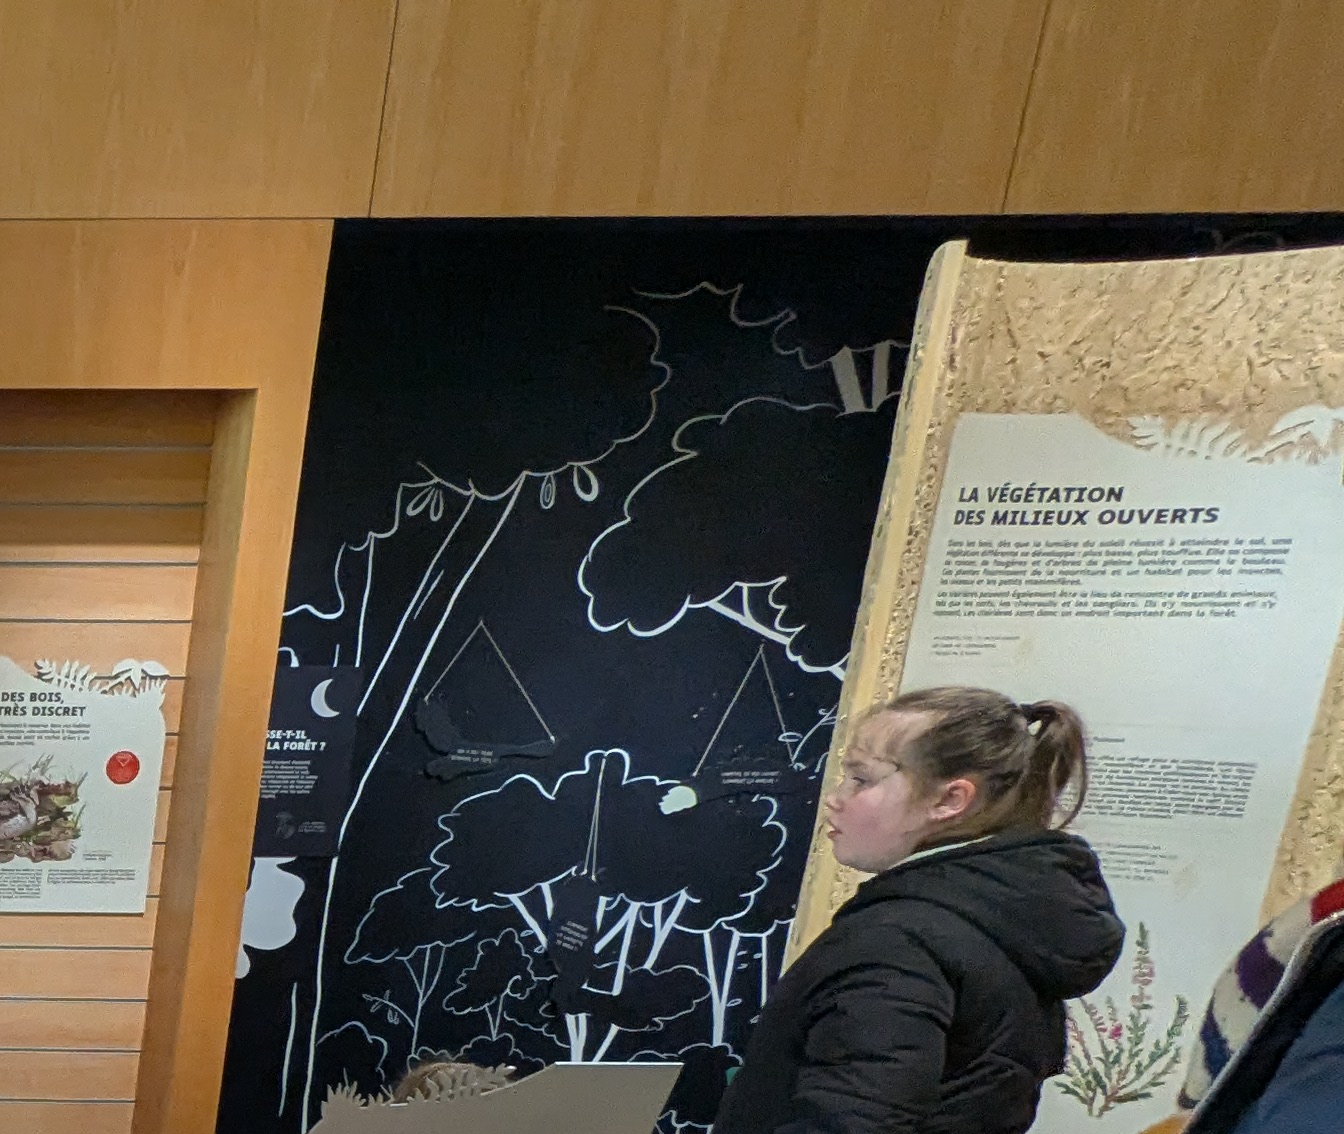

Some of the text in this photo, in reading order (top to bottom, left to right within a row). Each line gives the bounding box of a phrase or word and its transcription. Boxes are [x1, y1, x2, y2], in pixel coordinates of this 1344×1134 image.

[957, 482, 1124, 503] LA VÉGÉTATION
[953, 507, 1220, 526] DES MILIEUX OUVERTS
[1, 691, 25, 702] DES
[29, 691, 64, 704] BOIS,
[31, 706, 86, 716] DISCRET
[266, 738, 326, 751] LA FORÊT ?
